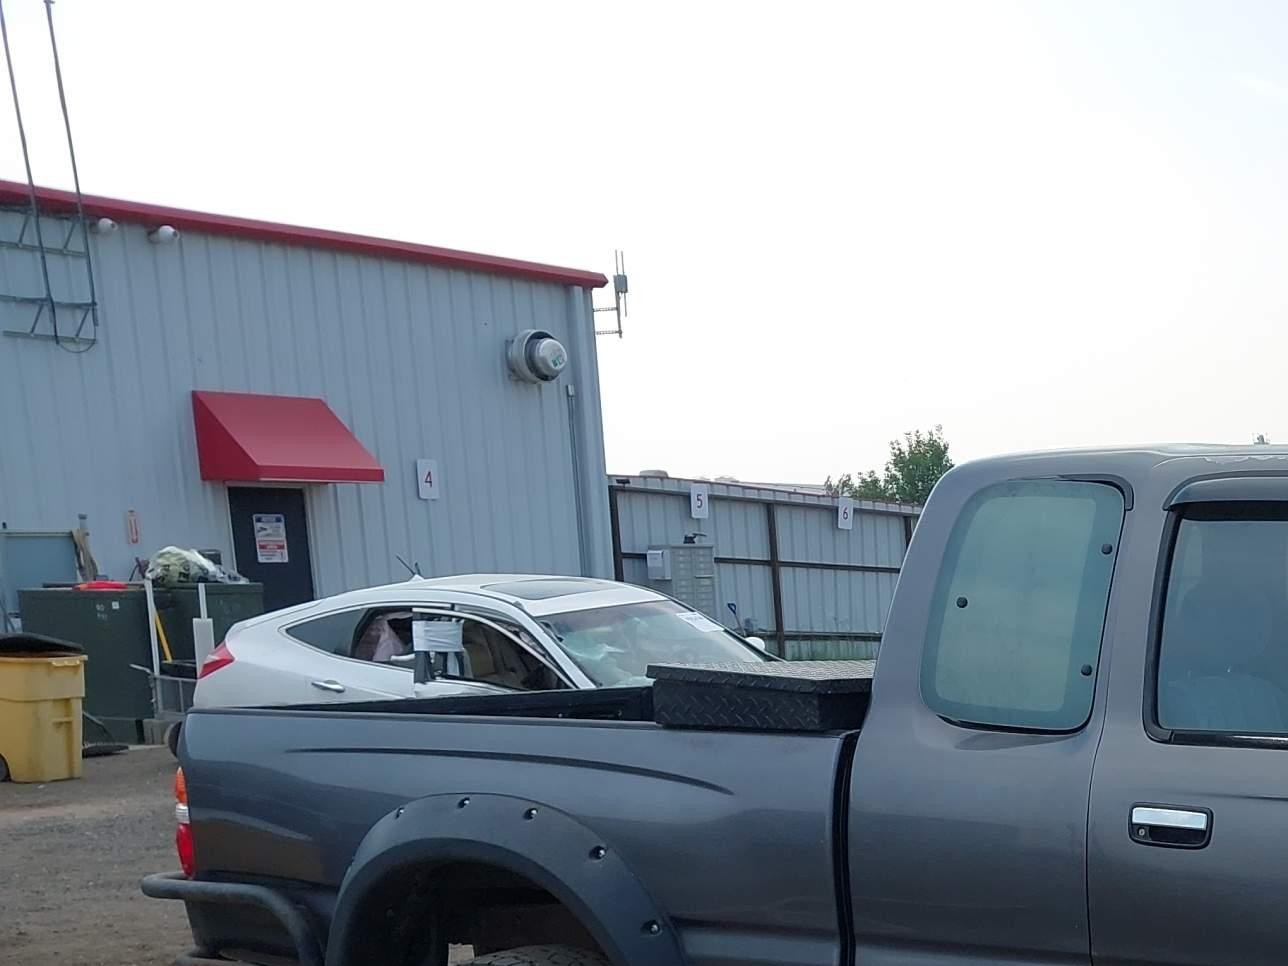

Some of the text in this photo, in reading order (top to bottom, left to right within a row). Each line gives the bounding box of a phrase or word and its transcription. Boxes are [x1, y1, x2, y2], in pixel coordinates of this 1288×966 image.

[424, 470, 433, 488] 4
[696, 493, 703, 509] 5
[842, 507, 849, 521] 6
